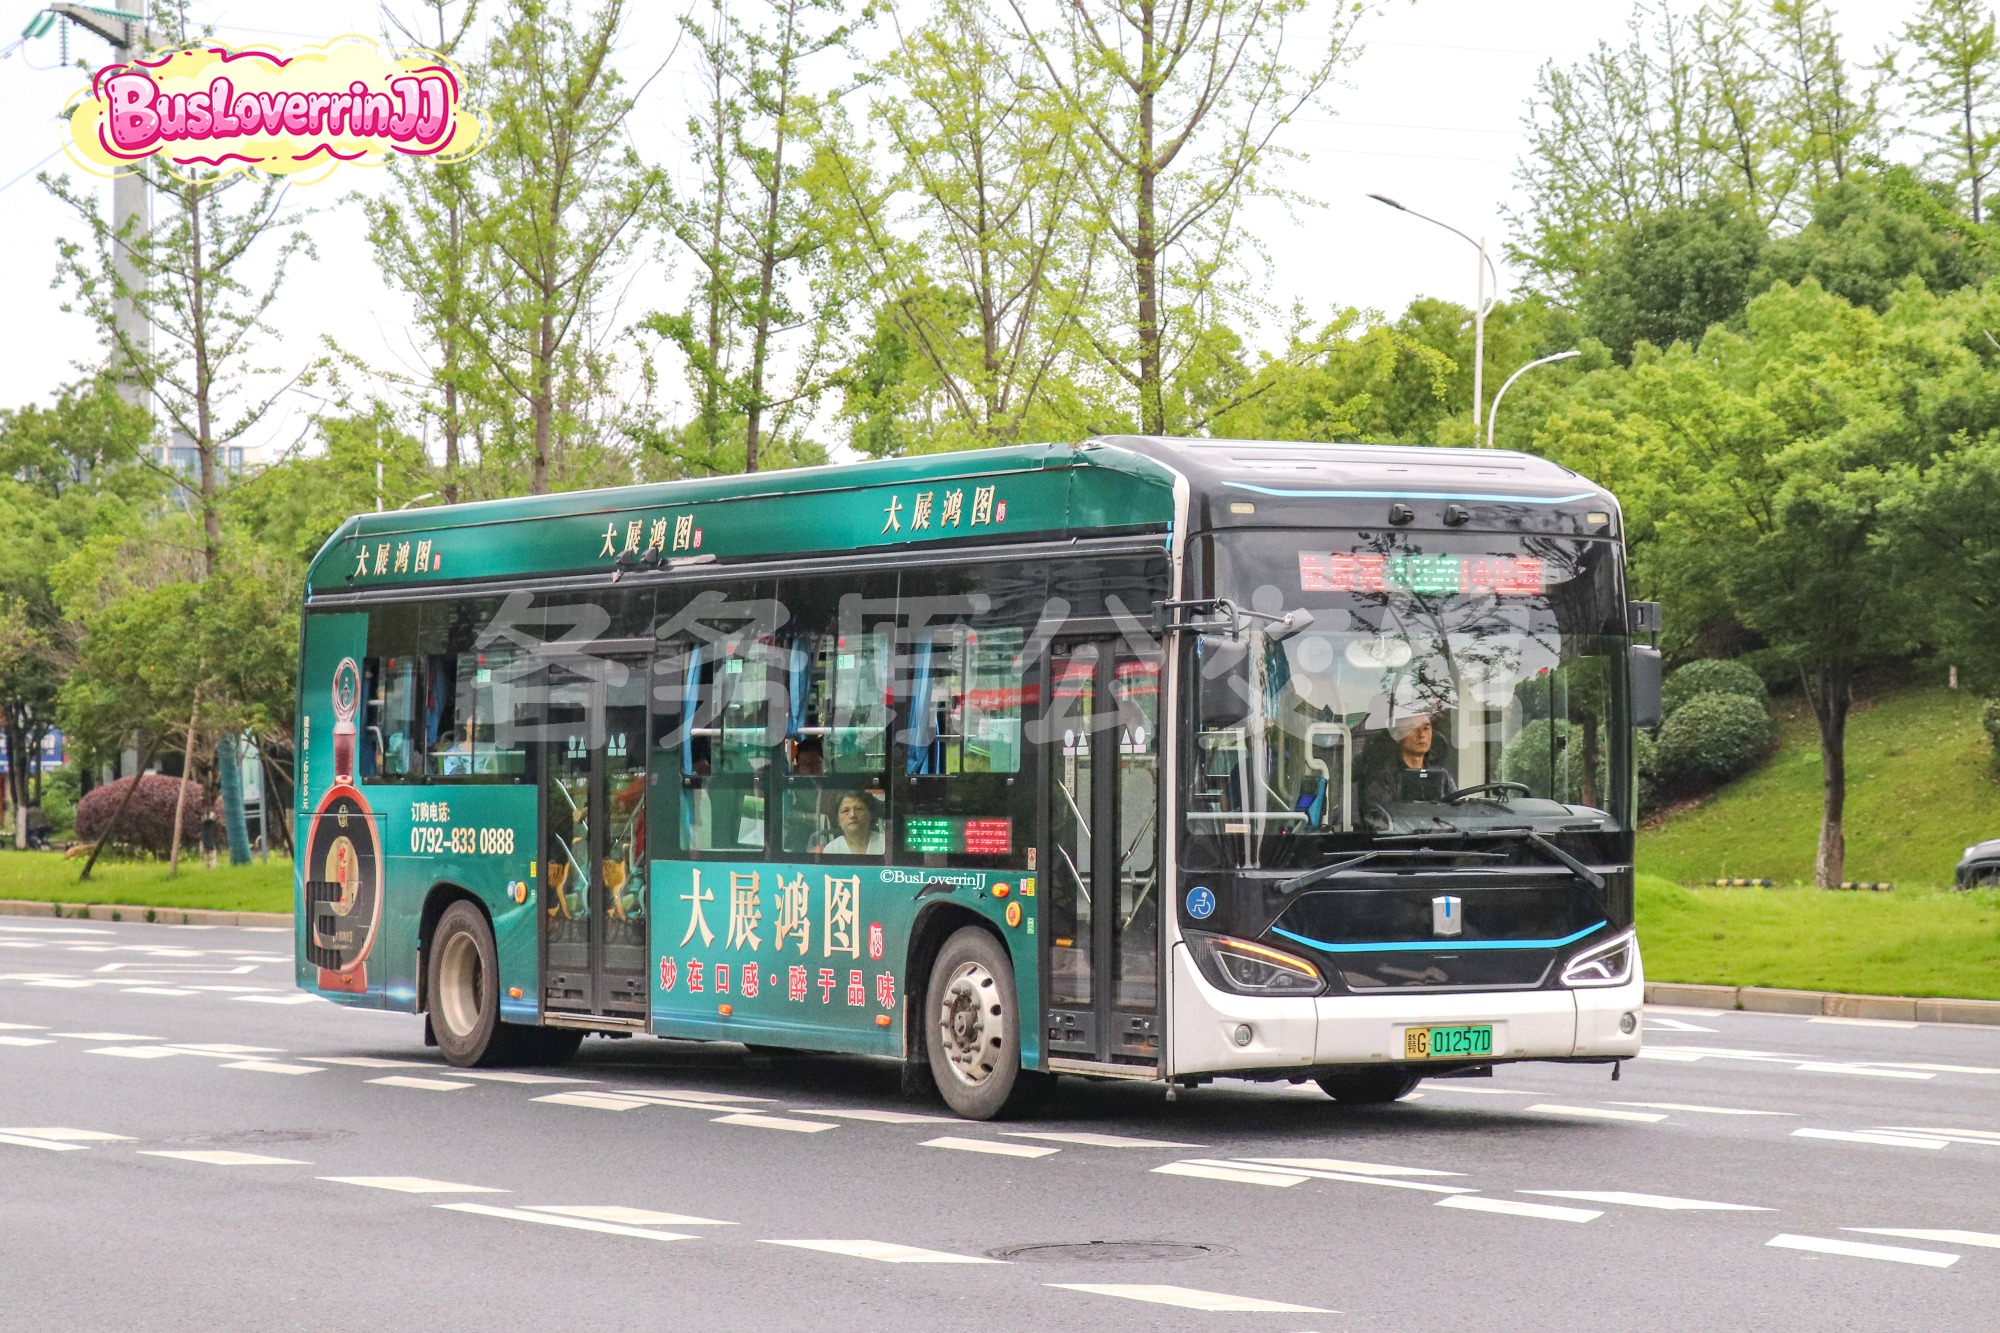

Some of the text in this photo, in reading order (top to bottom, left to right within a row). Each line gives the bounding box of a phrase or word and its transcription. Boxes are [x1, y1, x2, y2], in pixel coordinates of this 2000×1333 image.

[882, 485, 995, 534] 大展鸿图
[353, 539, 432, 577] 大展鸿图
[599, 514, 693, 558] 大展鸿图
[411, 827, 514, 854] 0792-833 0888
[679, 868, 860, 959] 大展鸿图
[659, 956, 896, 1009] 妙在口感·醉于品味
[1434, 1030, 1490, 1052] 01257D
